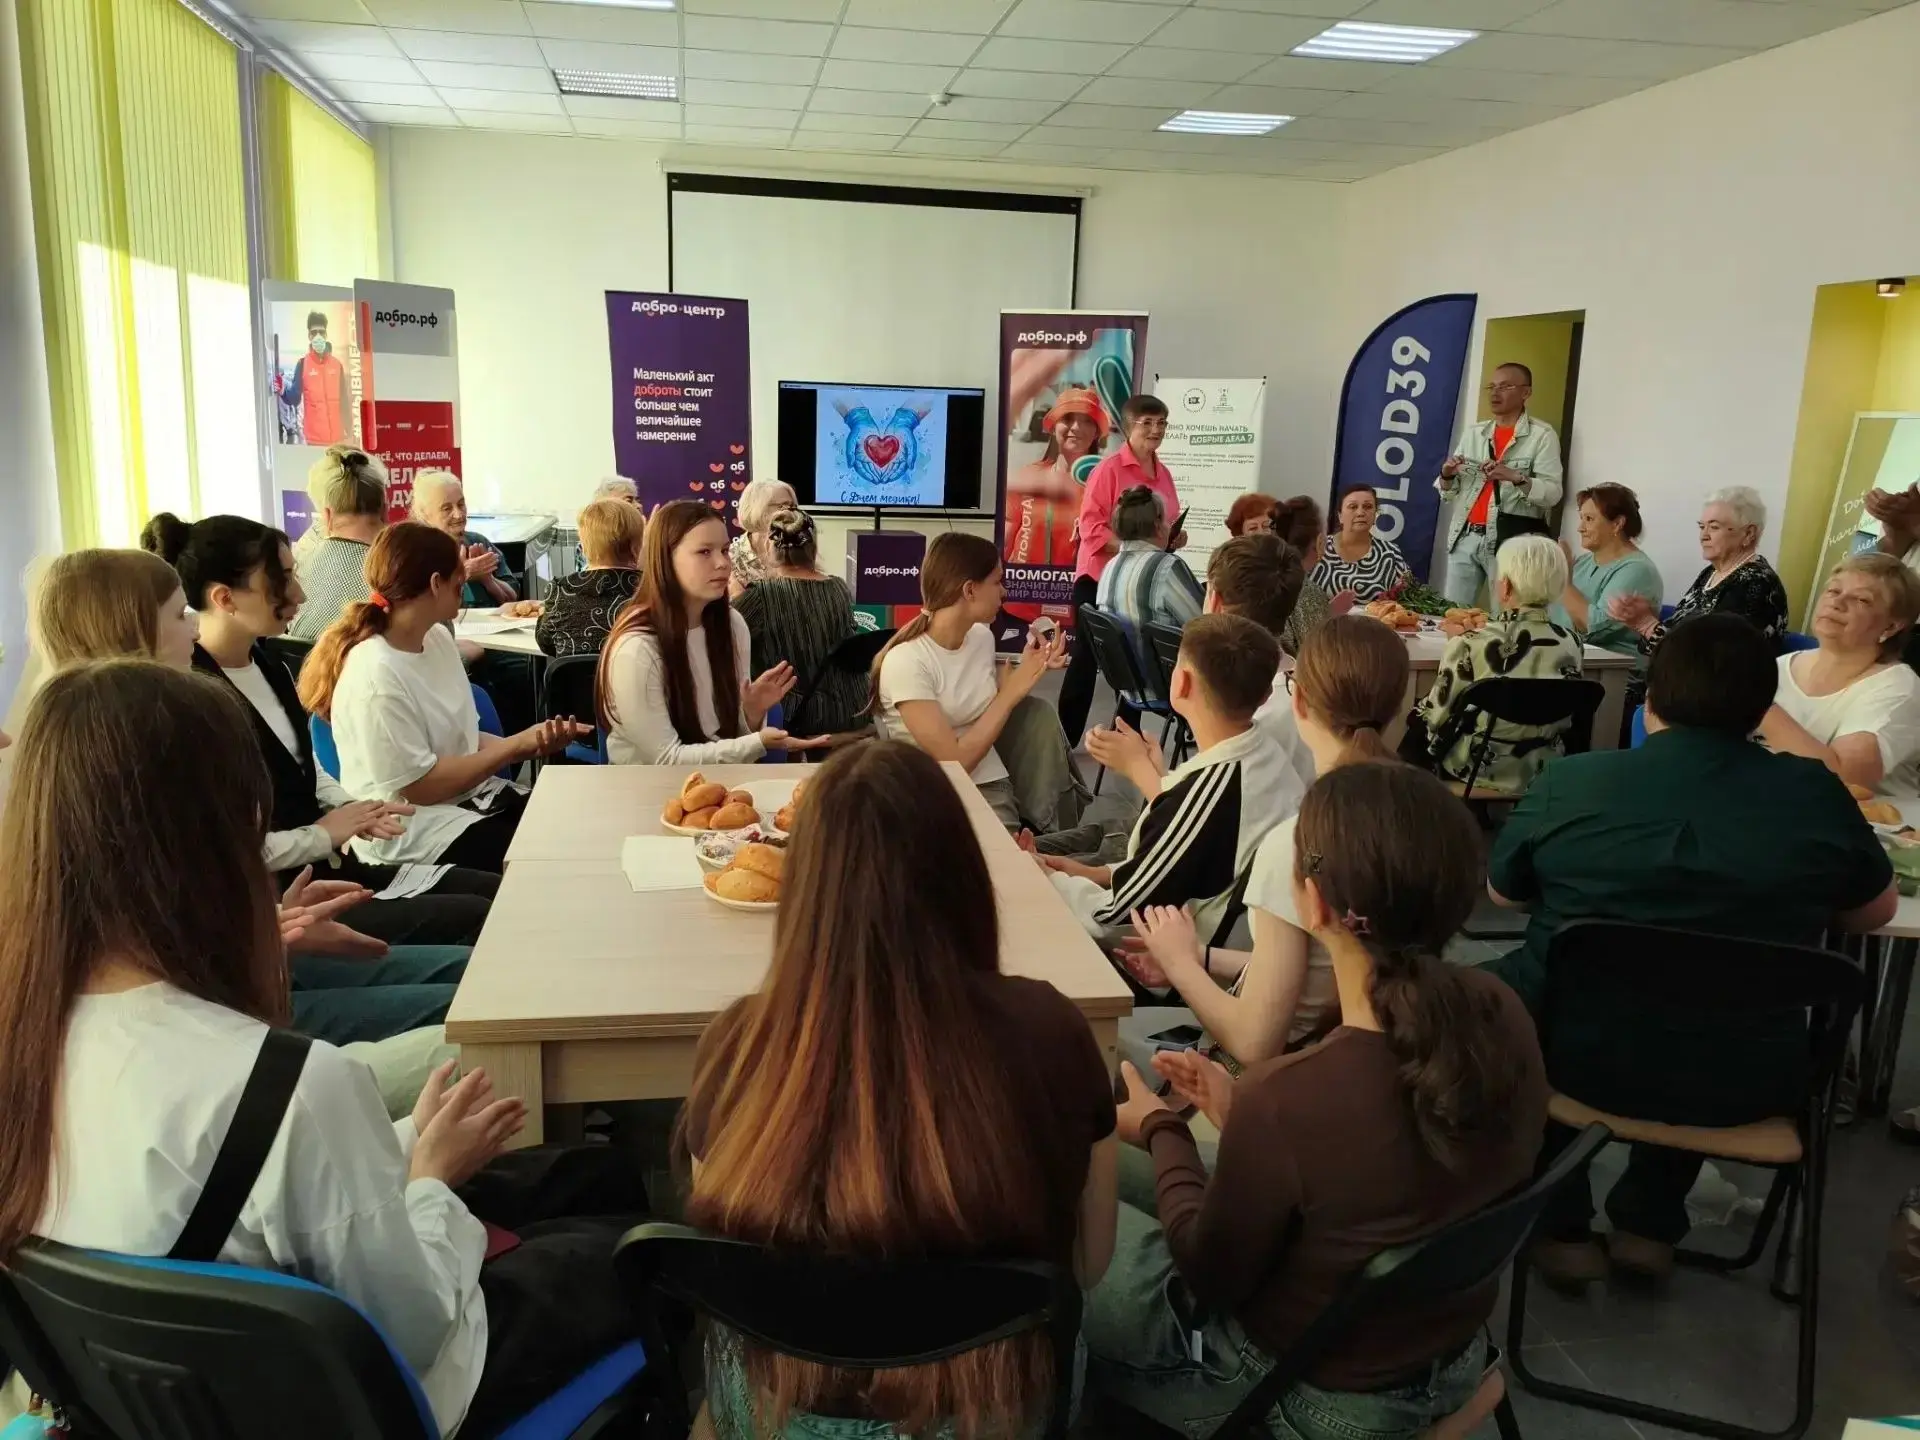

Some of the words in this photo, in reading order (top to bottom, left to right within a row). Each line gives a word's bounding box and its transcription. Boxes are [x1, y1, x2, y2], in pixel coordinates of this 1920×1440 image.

[375, 309, 438, 328] добро.рф
[1017, 331, 1088, 344] добро.рф
[633, 367, 695, 383] Маленький
[697, 371, 715, 383] акт
[634, 383, 682, 399] доброты
[683, 386, 714, 398] стоит
[635, 397, 677, 412] больше
[678, 401, 700, 412] чем
[635, 413, 702, 427] величайшее
[636, 428, 697, 443] намерение
[1186, 424, 1218, 432] ХОЧЕШЬ
[1219, 425, 1249, 433] НАЧАТЬ
[1371, 335, 1431, 542] OLOD39
[395, 452, 413, 461] ЧТО
[414, 451, 451, 462] ДЕЛАЕМ,
[864, 565, 920, 578] добро.рф
[1005, 568, 1077, 583] ПОМОГАТ
[1005, 580, 1048, 591] ЗНАЧИТ
[1005, 589, 1030, 599] МИР
